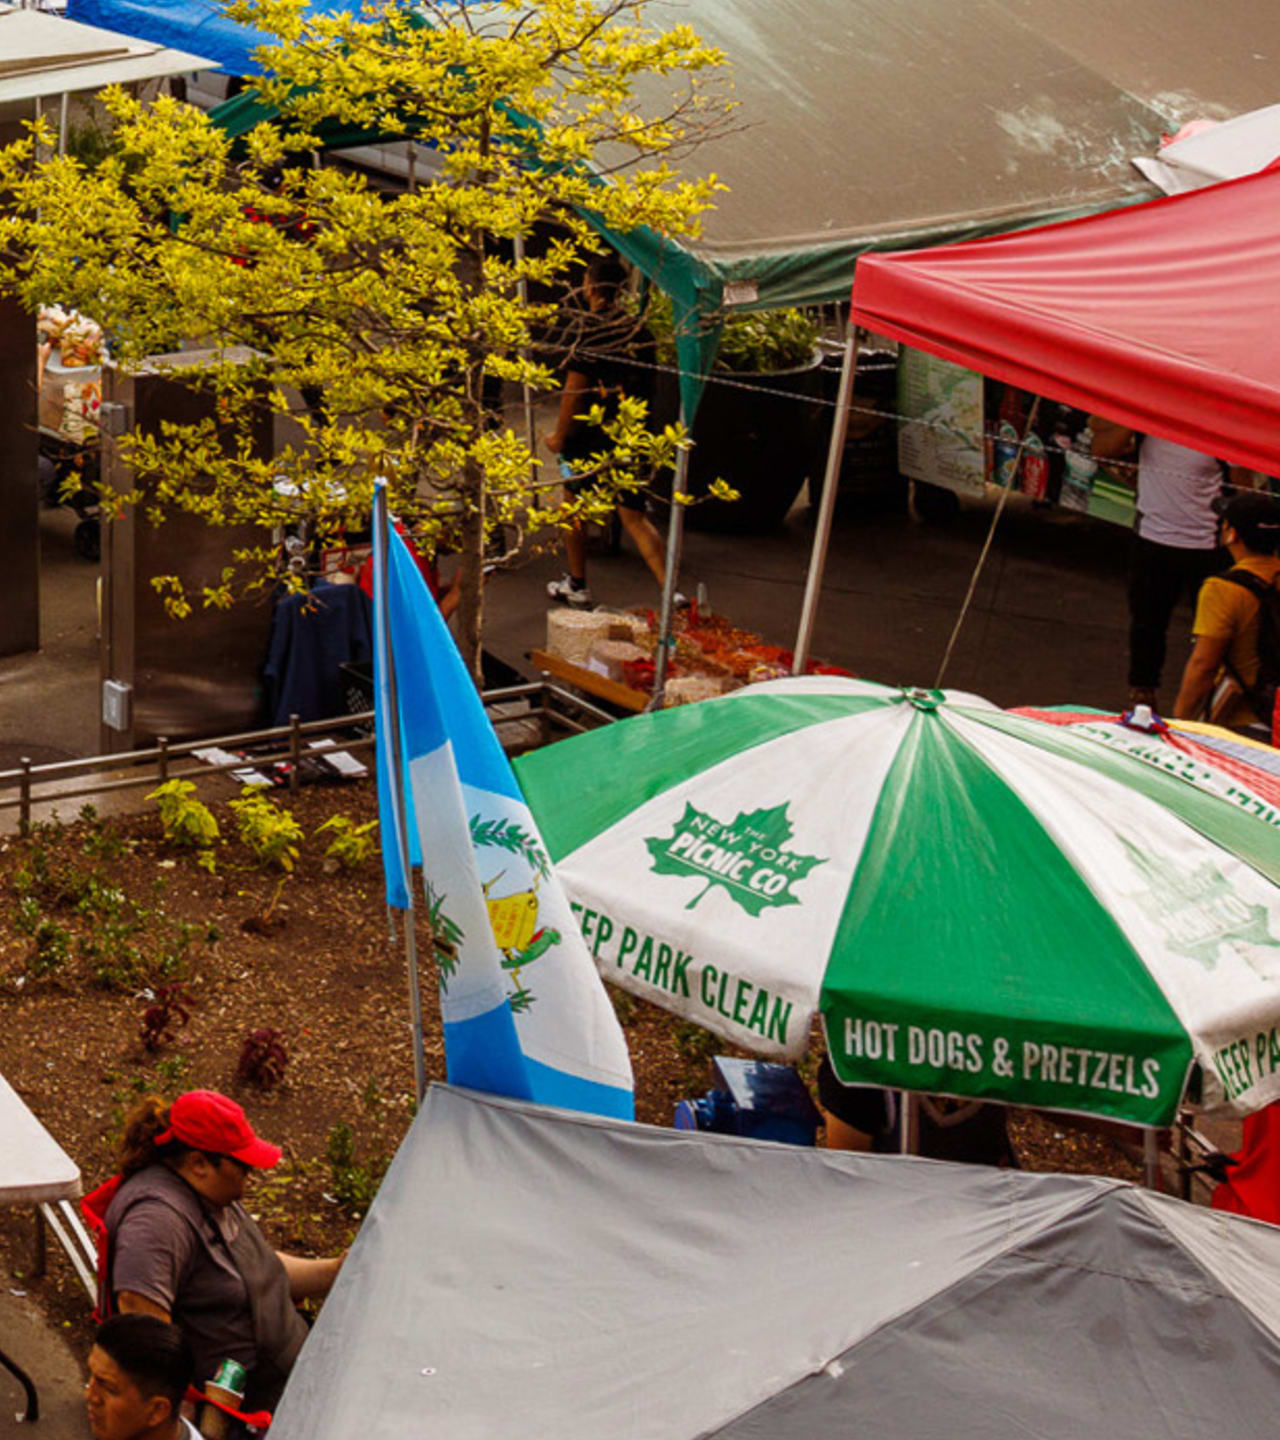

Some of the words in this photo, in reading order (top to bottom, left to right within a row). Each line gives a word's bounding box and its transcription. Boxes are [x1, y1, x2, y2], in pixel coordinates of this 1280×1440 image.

[690, 816, 742, 845] NEW
[744, 827, 766, 841] THE
[748, 841, 804, 872] YORK
[749, 867, 788, 895] CO
[570, 902, 614, 957] EP
[617, 926, 693, 998] PARK
[700, 965, 793, 1045] CLEAN
[845, 1018, 898, 1061] HOT
[908, 1026, 983, 1073] DOGS
[992, 1037, 1014, 1078] &
[1023, 1041, 1161, 1099] PRETZELS
[1213, 1039, 1254, 1101] KEEP
